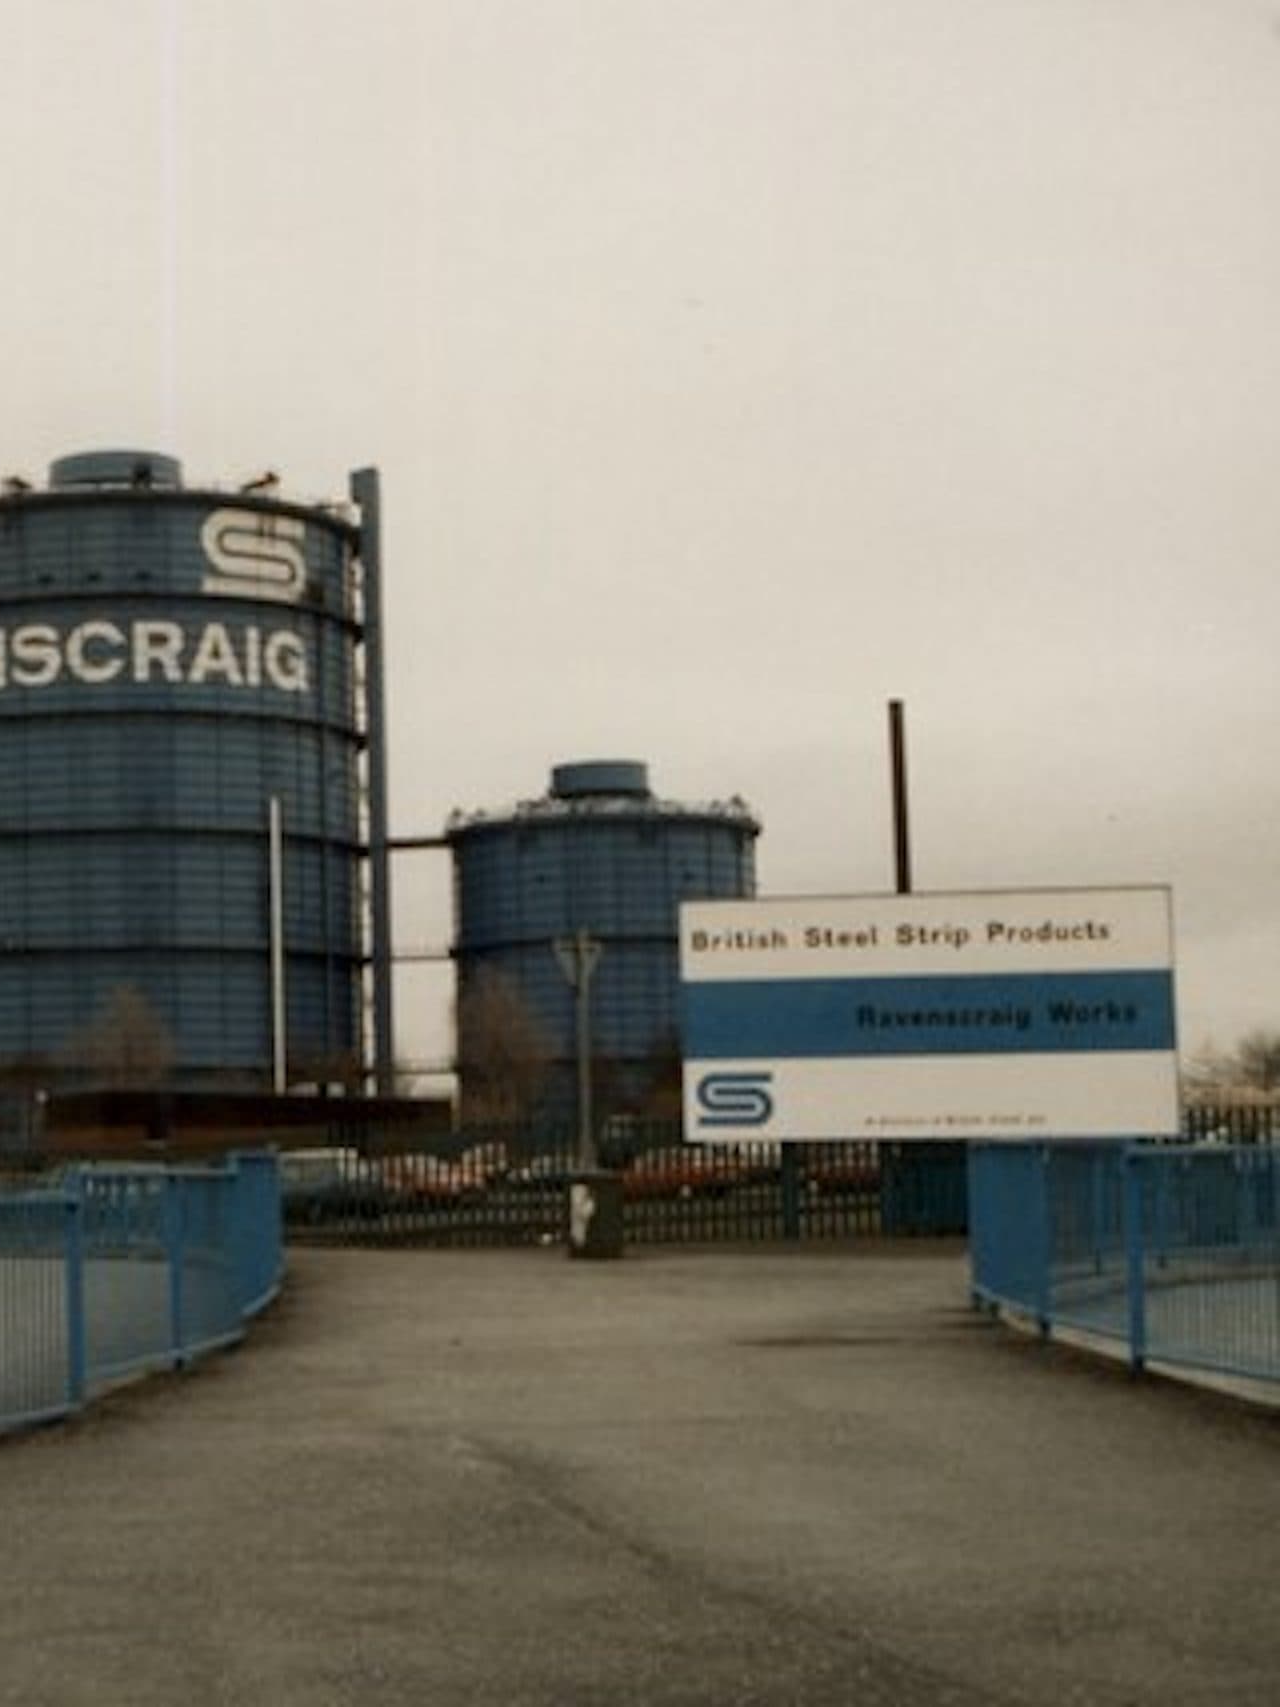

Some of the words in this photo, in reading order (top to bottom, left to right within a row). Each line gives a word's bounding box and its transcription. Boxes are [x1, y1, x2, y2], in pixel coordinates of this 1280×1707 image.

[691, 926, 788, 951] British
[805, 924, 878, 948] Steel
[896, 923, 970, 949] Strip
[987, 920, 1110, 943] Products
[857, 1003, 1032, 1031] Ravenscraig
[1048, 999, 1138, 1024] Works
